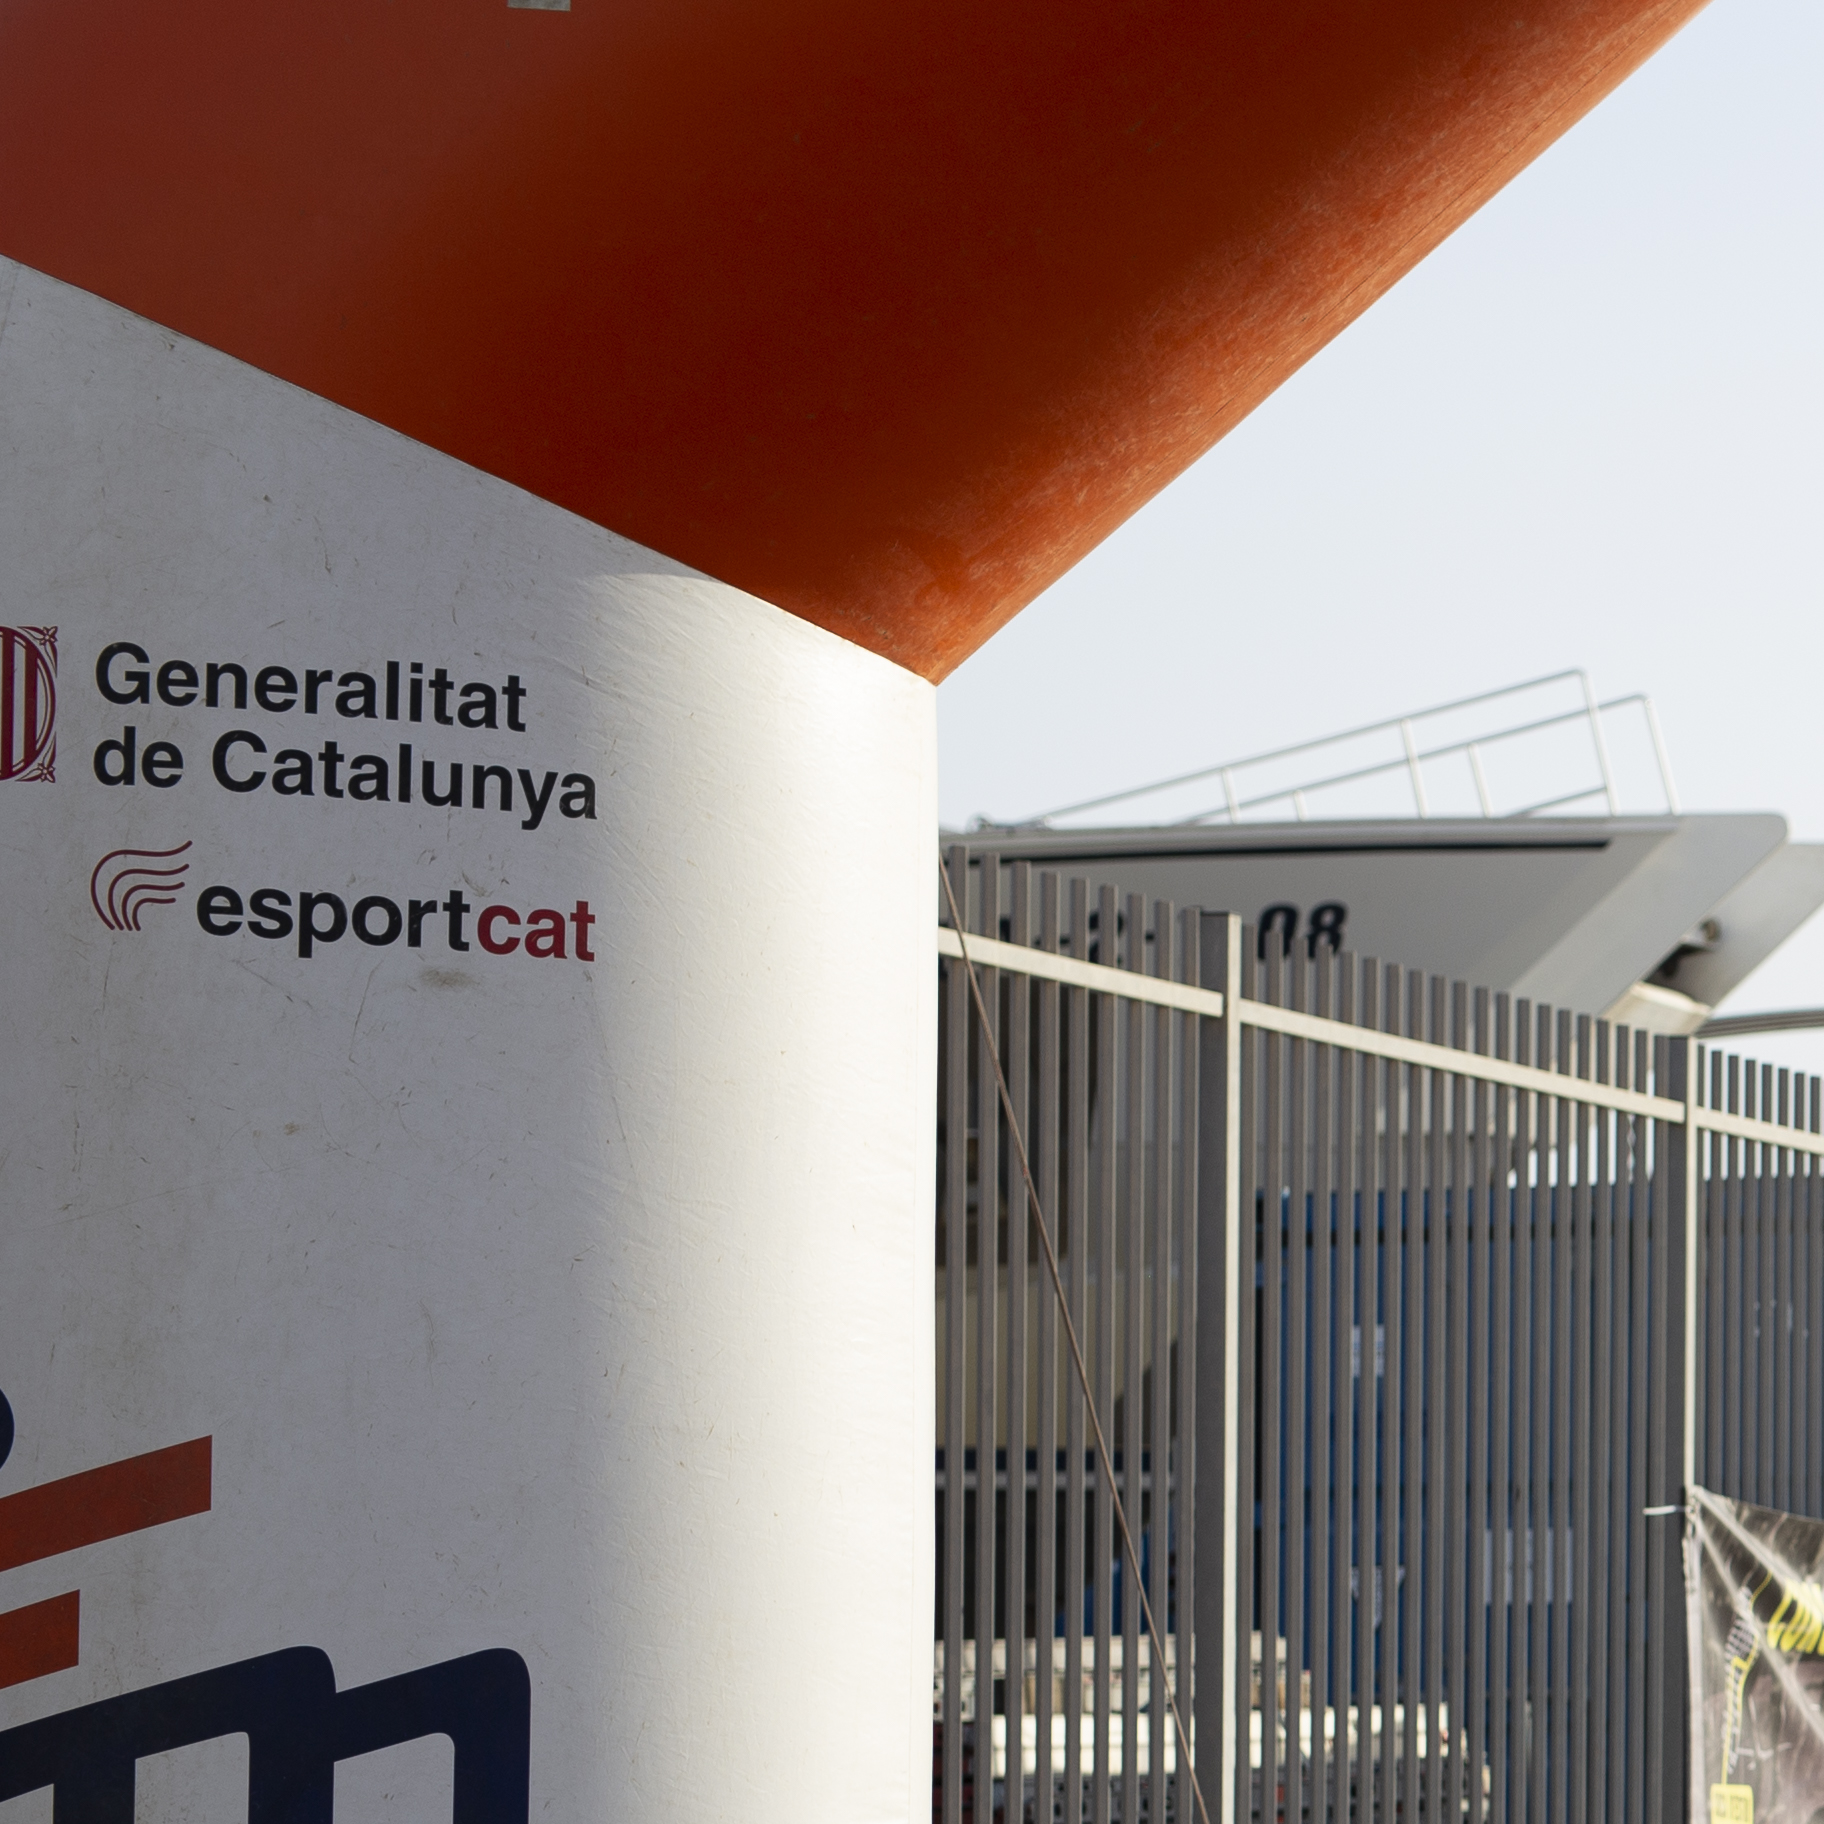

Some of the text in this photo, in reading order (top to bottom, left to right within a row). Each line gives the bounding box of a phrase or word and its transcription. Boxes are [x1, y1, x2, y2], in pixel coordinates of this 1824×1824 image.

[95, 641, 527, 733] Generalitat
[93, 727, 597, 831] de Catalunya
[197, 884, 596, 962] esportcat
